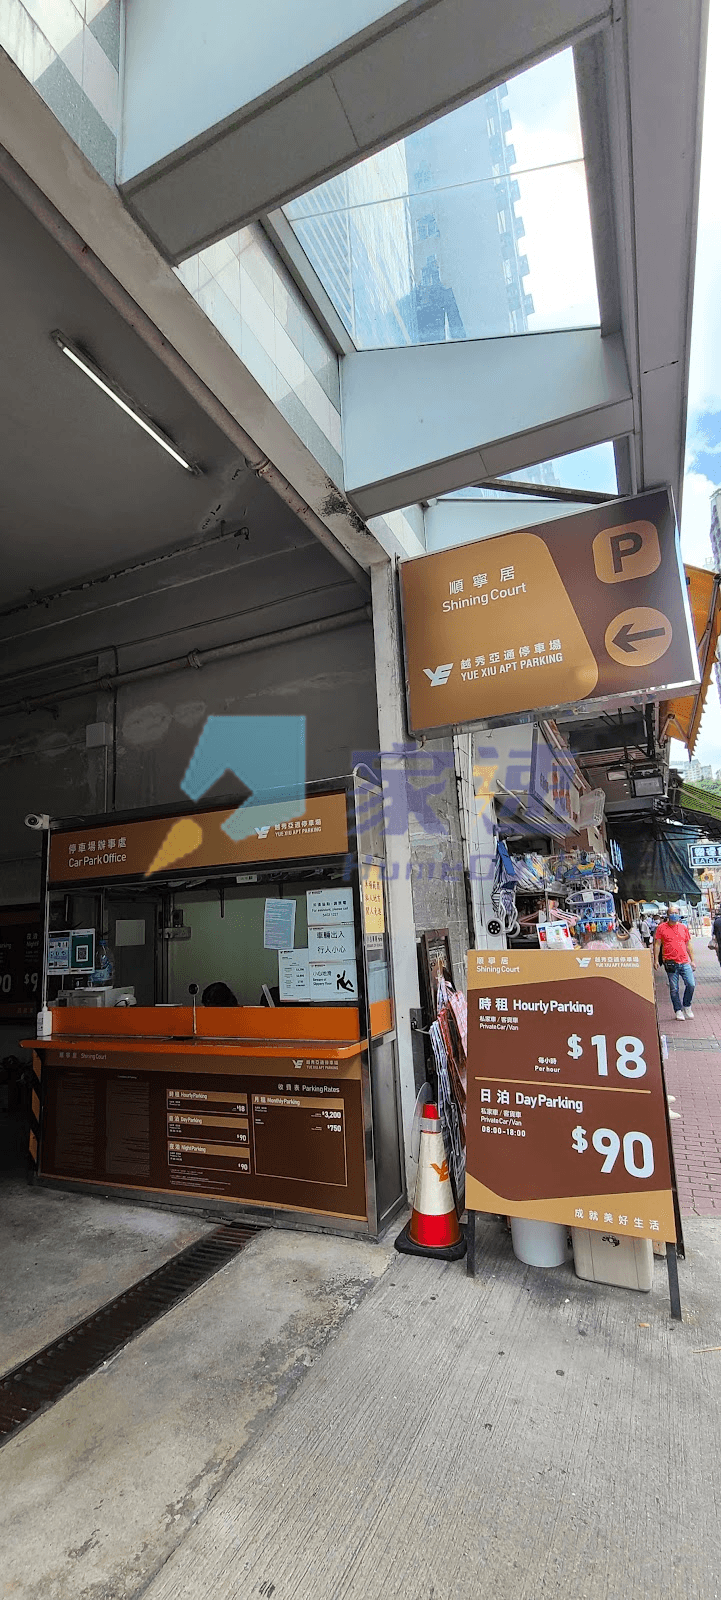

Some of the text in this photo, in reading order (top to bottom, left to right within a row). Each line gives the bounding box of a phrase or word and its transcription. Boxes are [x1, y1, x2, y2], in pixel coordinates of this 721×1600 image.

[609, 531, 643, 574] P
[449, 565, 515, 595] 順寧居
[442, 582, 527, 612] Shining Court
[460, 639, 562, 670] 越秀亞通停車場
[461, 652, 563, 682] YUE XIU APT PARKING
[301, 826, 322, 834] PARKING
[68, 836, 127, 854] 停車場辦事處
[68, 852, 127, 868] Car Park Office
[316, 930, 345, 939] 車輛出入
[317, 945, 347, 954] 行人小心
[476, 965, 501, 974] Shining
[478, 997, 594, 1016] 時租 Hourly Parking
[80, 1052, 96, 1061] Shining
[537, 1056, 557, 1065] 每小時
[545, 1065, 561, 1073] hour
[277, 1083, 340, 1094] 收費表 Parking Rates
[180, 1091, 193, 1099] Hourly
[192, 1092, 208, 1100] Parking
[266, 1097, 284, 1105] Monthly
[480, 1088, 584, 1113] 日泊 Day Parking
[321, 1110, 342, 1119] $3,200
[187, 1117, 203, 1125] Parking
[326, 1124, 342, 1132] $750
[481, 1125, 526, 1137] 08:00-18:00
[236, 1134, 247, 1142] $90
[180, 1144, 192, 1152] Night
[191, 1145, 207, 1153] Parking
[571, 1125, 655, 1179] $90
[238, 1162, 248, 1171] $90
[574, 1208, 660, 1231] 成就美好生活
